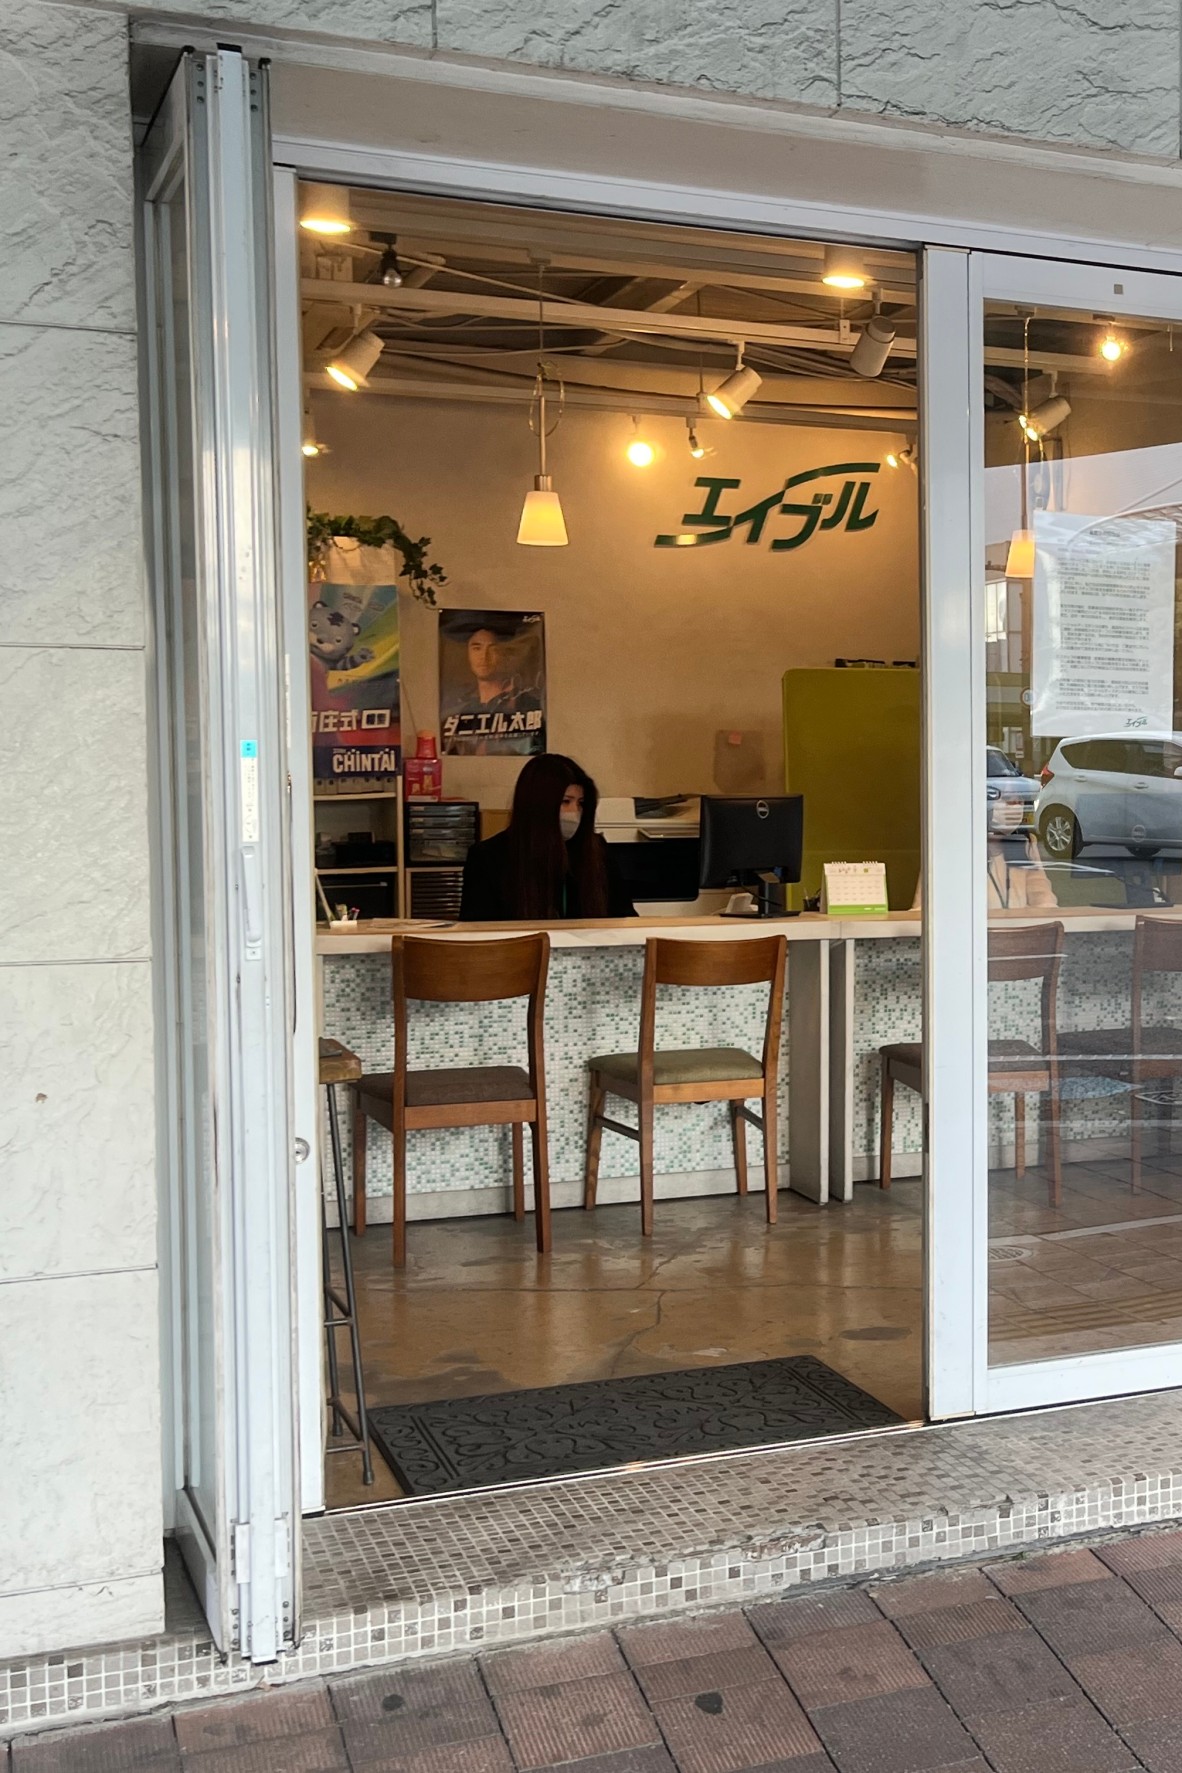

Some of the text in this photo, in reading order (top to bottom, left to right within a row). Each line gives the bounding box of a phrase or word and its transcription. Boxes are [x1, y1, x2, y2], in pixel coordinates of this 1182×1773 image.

[654, 462, 882, 552] エイブル
[443, 710, 543, 738] ダニエル太郎
[332, 748, 397, 773] CHINTAI
